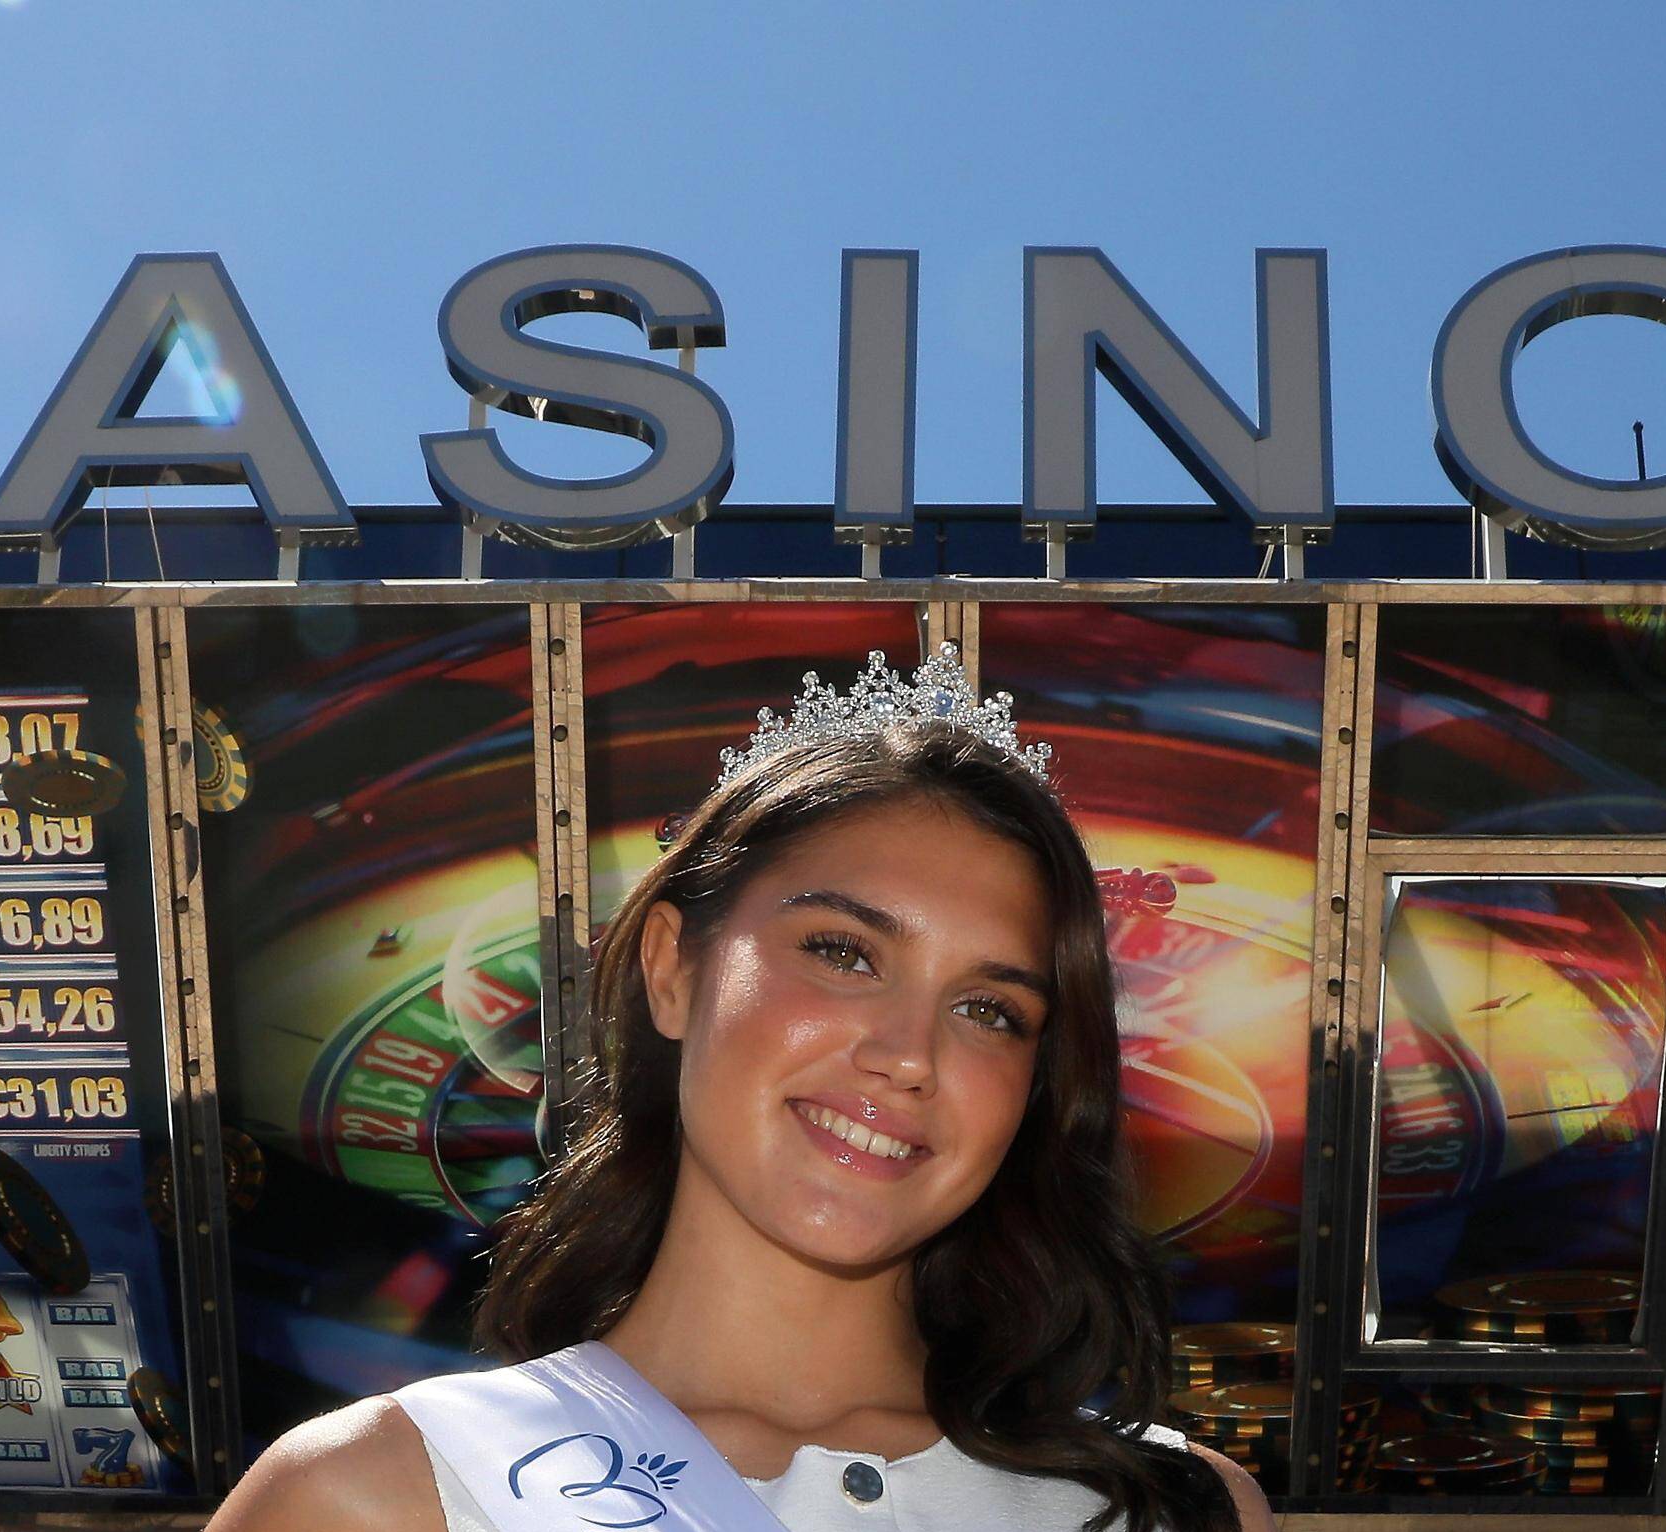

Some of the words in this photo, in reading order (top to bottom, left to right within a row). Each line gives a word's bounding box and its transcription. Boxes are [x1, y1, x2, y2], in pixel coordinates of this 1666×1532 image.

[363, 1039, 447, 1083] 19
[344, 1072, 428, 1118] 15
[340, 1112, 420, 1152] 32
[33, 1143, 71, 1157] LIBERTY
[73, 1143, 112, 1157] STRIPES
[54, 1305, 108, 1322] BAR
[64, 1361, 119, 1378] BAR
[69, 1388, 125, 1404] BAR
